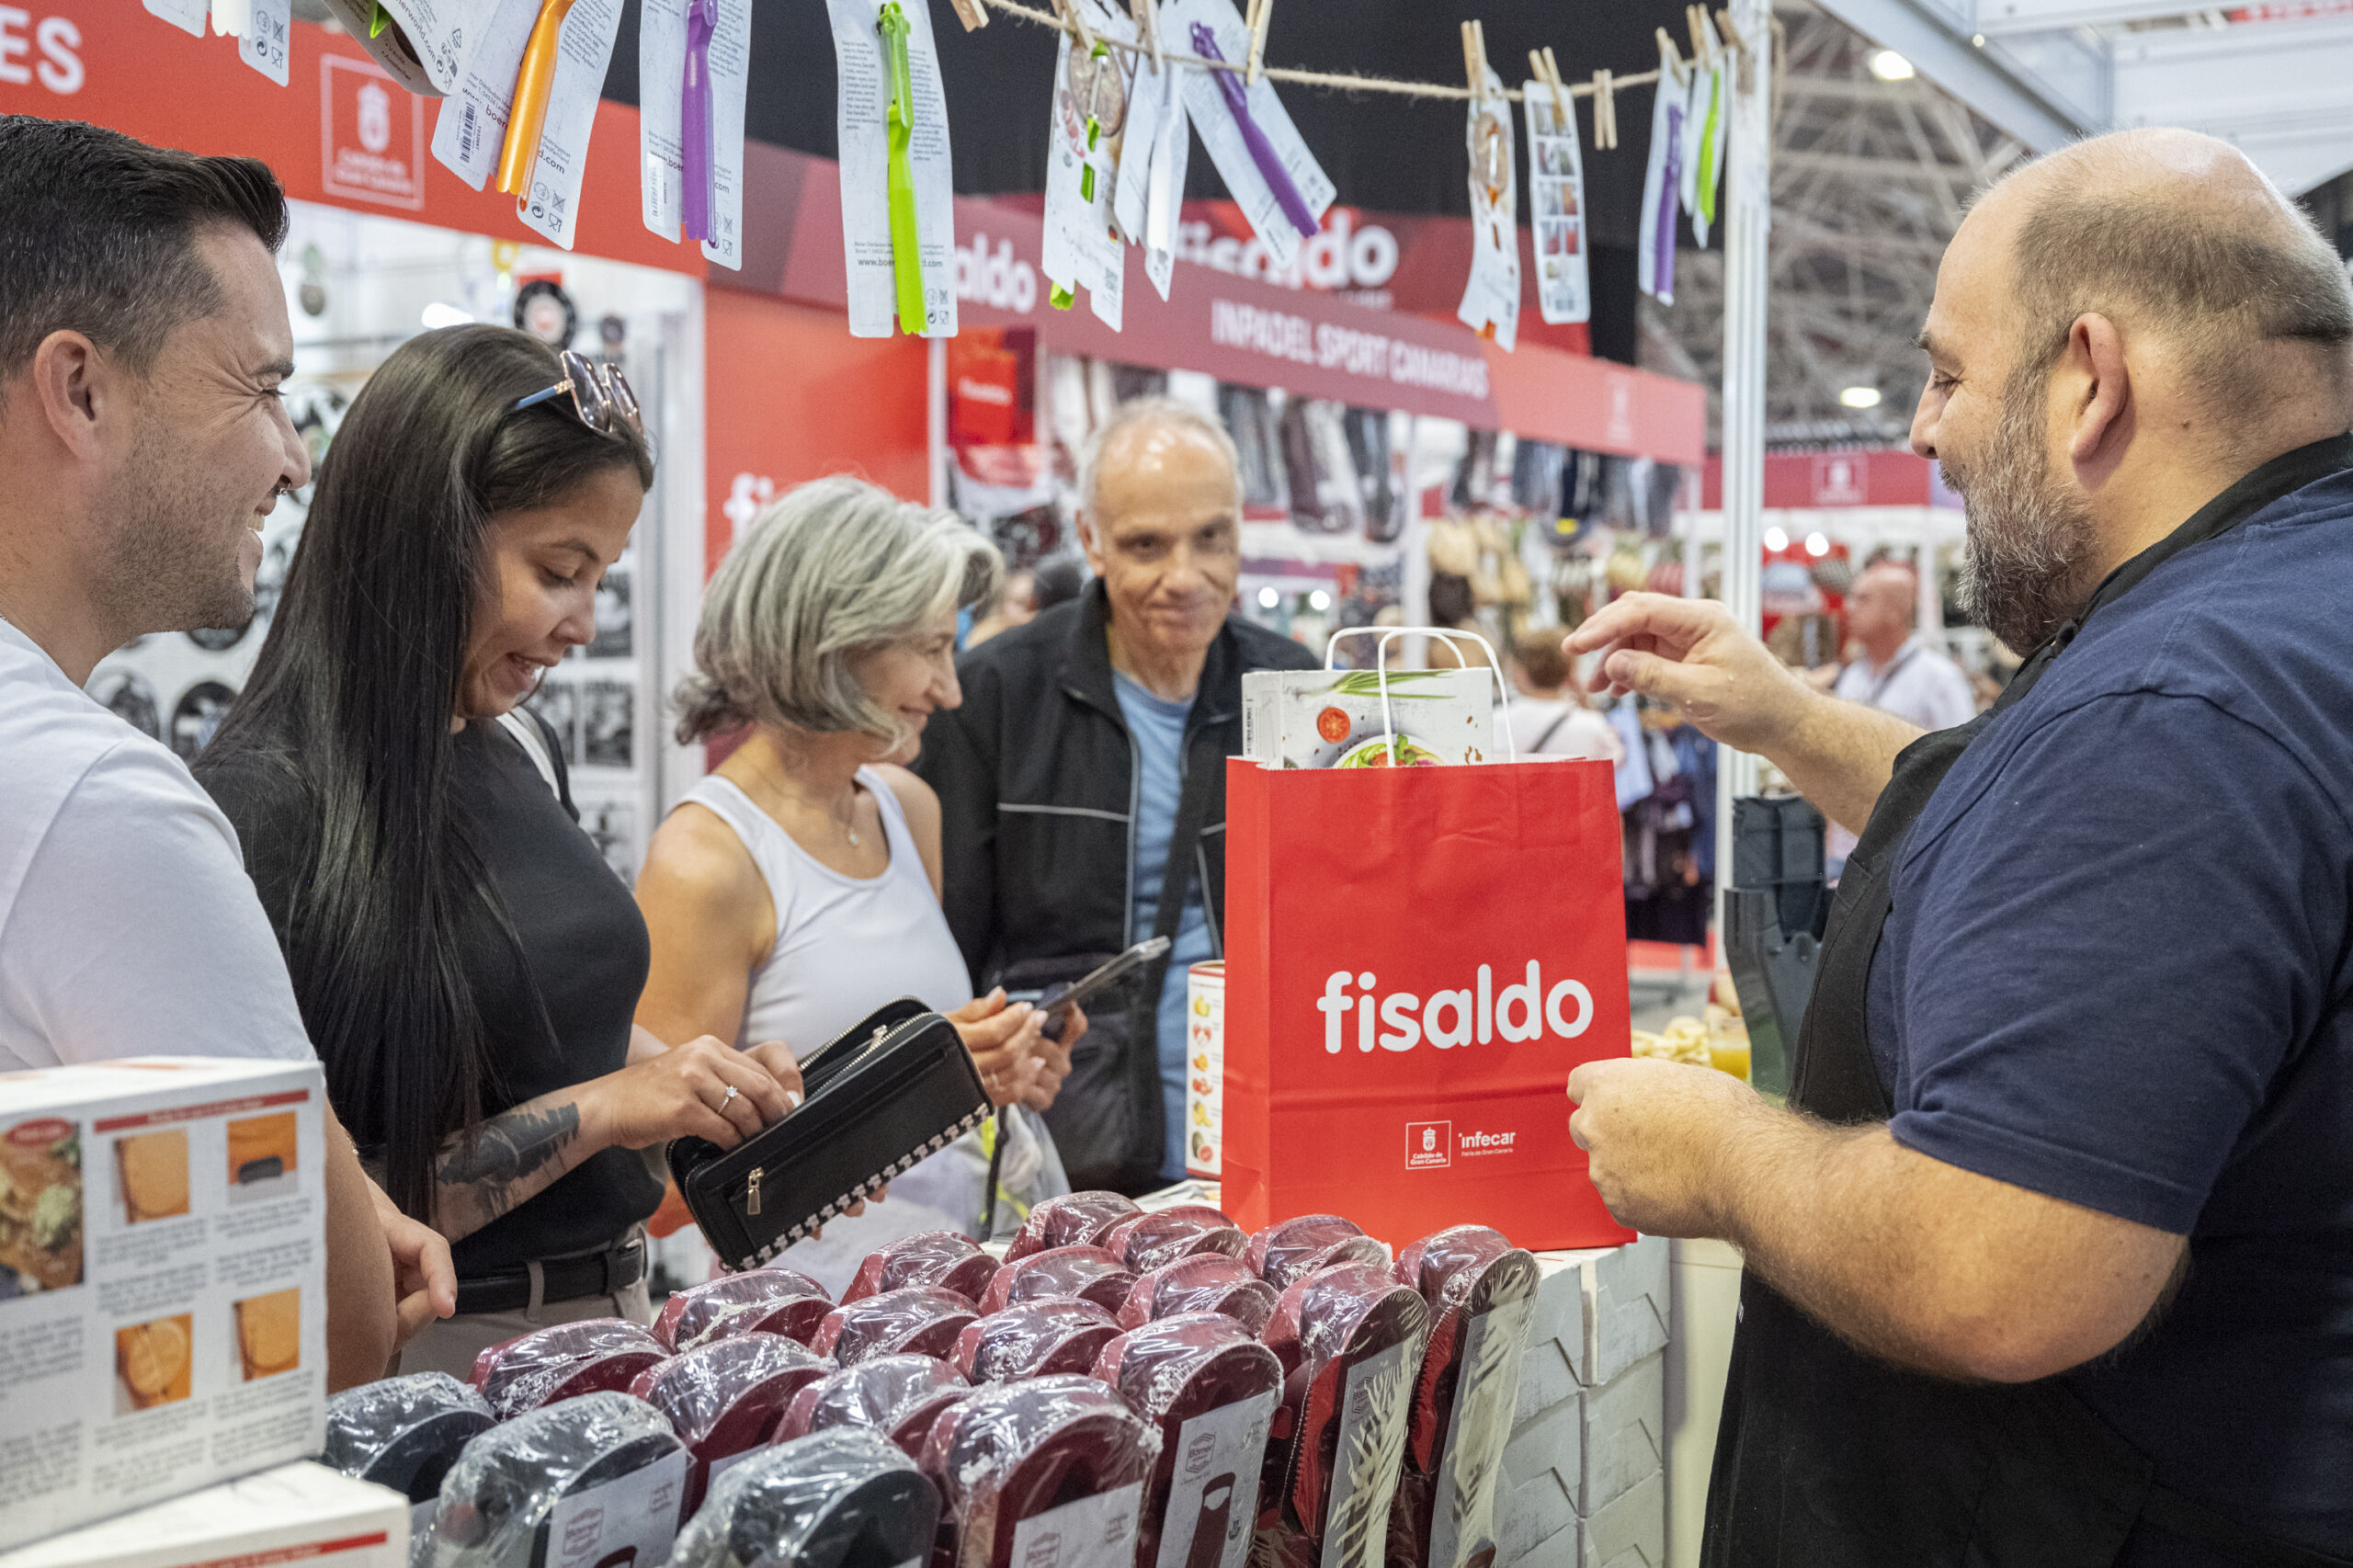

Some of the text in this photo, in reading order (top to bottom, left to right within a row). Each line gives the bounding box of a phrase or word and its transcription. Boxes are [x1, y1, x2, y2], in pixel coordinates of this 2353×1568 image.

[0, 5, 85, 94] ES
[1316, 959, 1594, 1054] fisaldo
[1458, 1131, 1516, 1148] infecar
